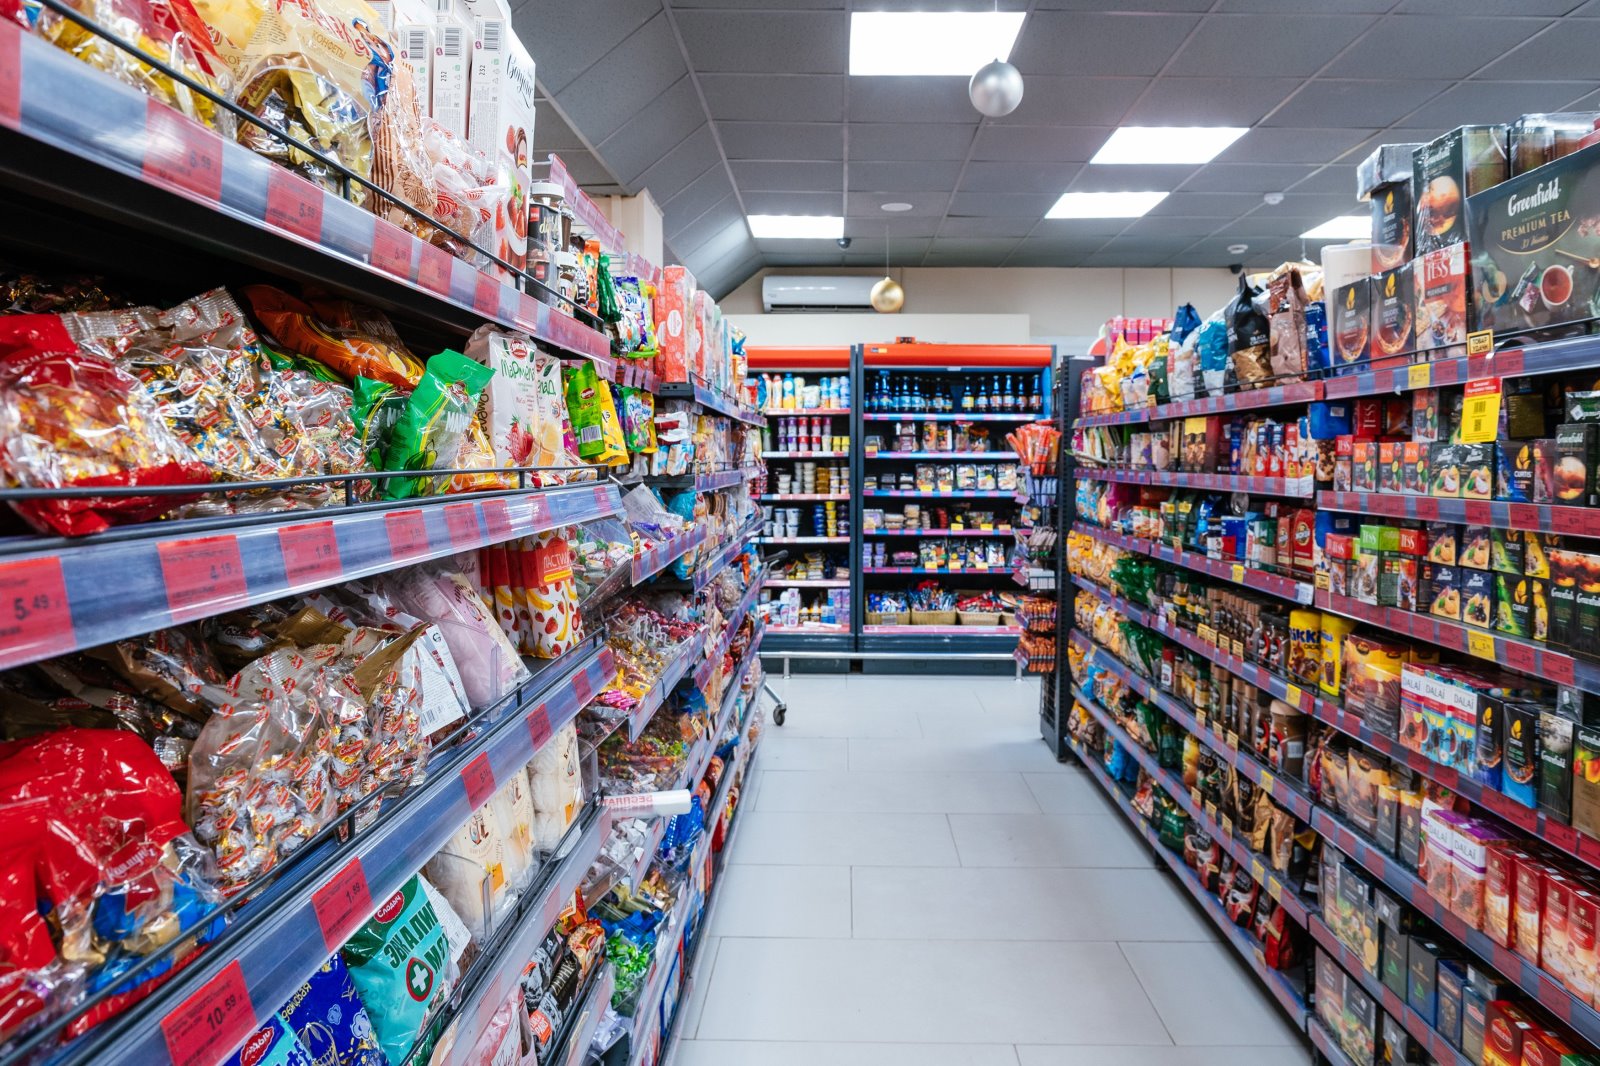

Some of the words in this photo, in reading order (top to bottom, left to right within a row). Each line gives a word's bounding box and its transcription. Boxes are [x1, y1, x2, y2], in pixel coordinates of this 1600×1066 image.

[312, 29, 347, 60] КОНФЕТЫ
[1508, 177, 1559, 217] Greenfield
[1501, 218, 1547, 241] PREMIUM
[1550, 209, 1571, 225] TEA
[1513, 470, 1532, 479] CURTIS
[1363, 530, 1376, 544] TESS
[1401, 534, 1415, 549] TESS
